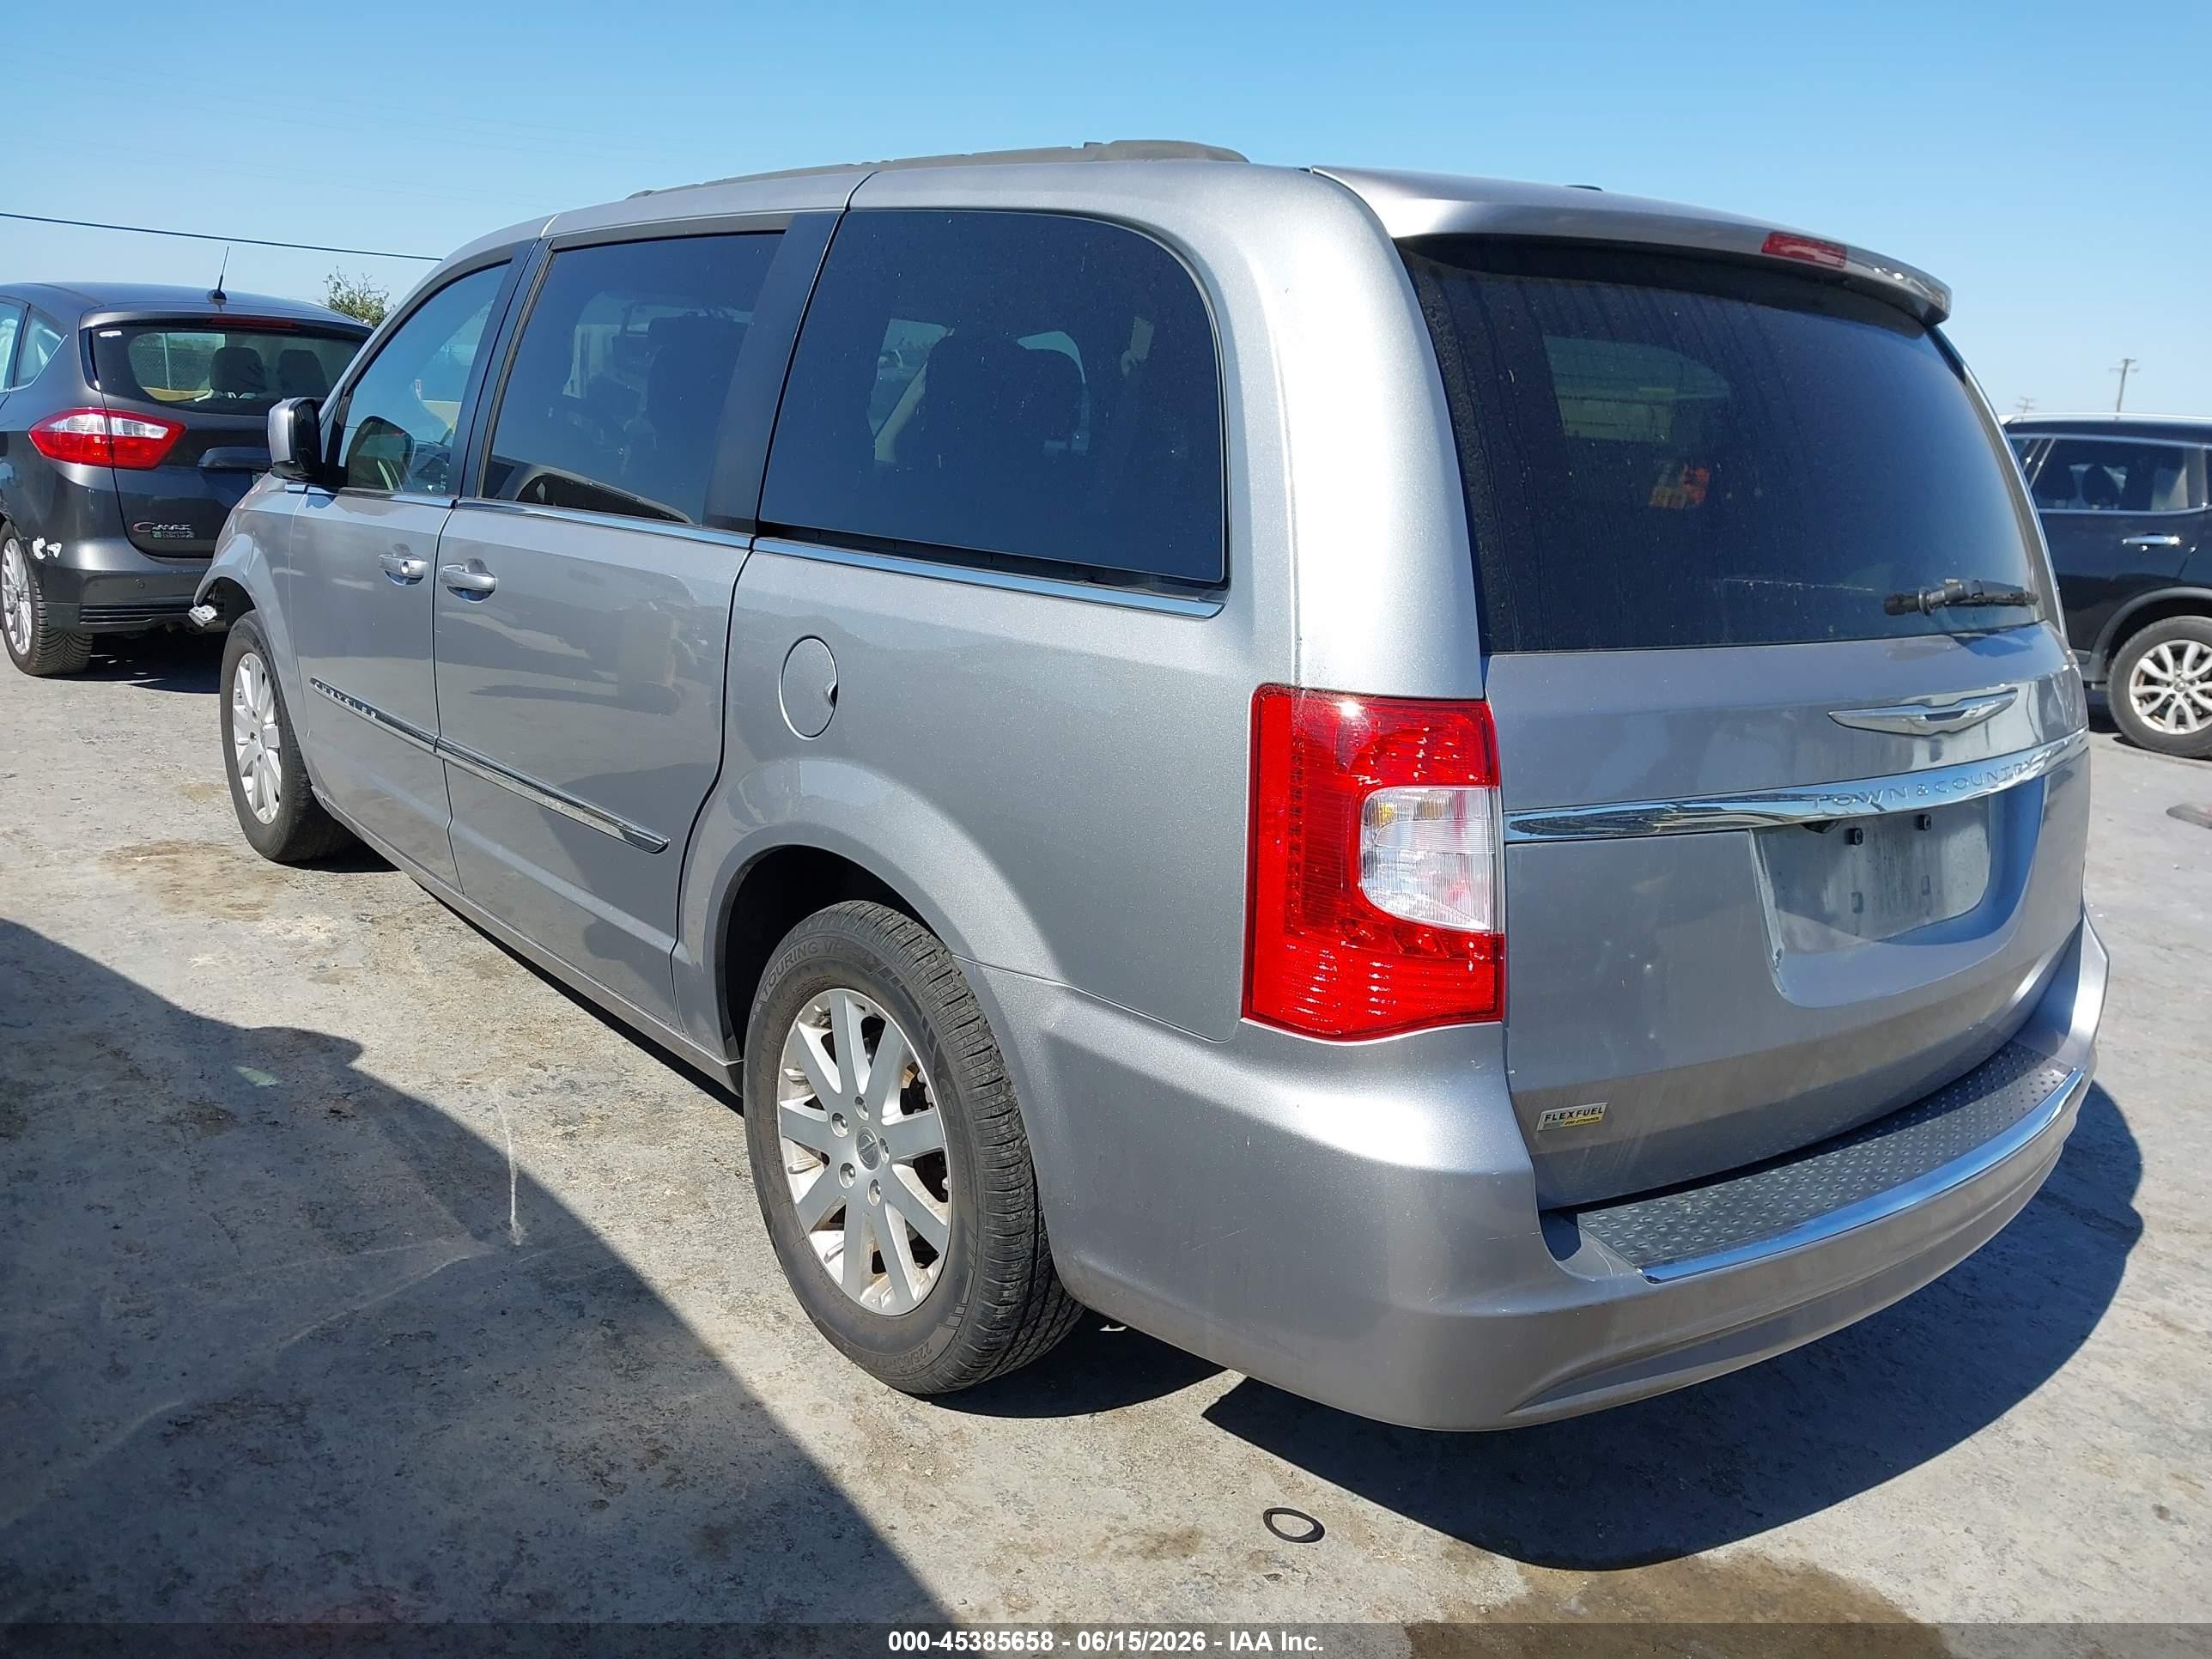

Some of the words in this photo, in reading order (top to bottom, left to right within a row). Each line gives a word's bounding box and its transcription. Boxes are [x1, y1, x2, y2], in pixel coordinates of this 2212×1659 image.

[313, 681, 377, 720] CHRYSLER
[1812, 786, 1909, 810] TOWN
[1916, 783, 1930, 797] &
[1934, 759, 2034, 795] COUNTRY
[761, 940, 818, 997] TOURING
[1545, 1106, 1603, 1121] FLEXFUEL
